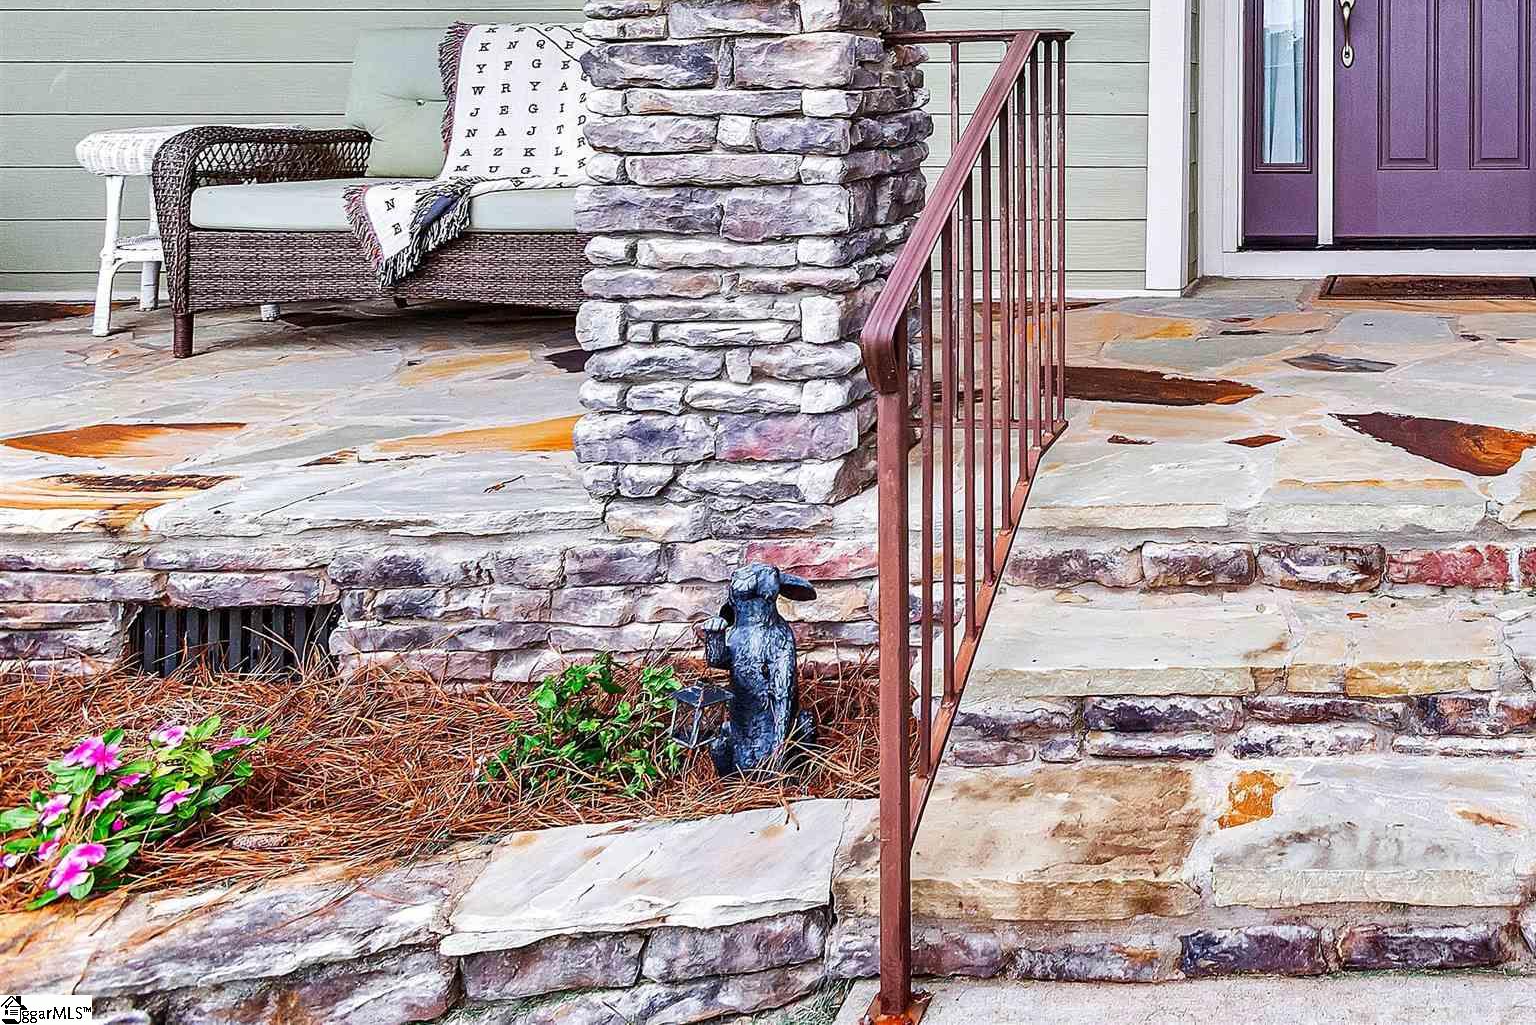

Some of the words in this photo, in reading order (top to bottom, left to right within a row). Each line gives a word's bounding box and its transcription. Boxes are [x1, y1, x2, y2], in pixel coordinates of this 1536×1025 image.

[479, 43, 491, 51] K
[507, 41, 519, 49] N
[536, 40, 545, 49] Q
[476, 64, 487, 73] Y
[504, 61, 512, 70] F
[532, 59, 542, 68] G
[472, 86, 485, 95] W
[501, 84, 511, 93] R
[529, 82, 541, 91] Y
[558, 82, 568, 91] A
[470, 108, 480, 117] J
[499, 106, 509, 115] E
[528, 104, 539, 113] G
[560, 104, 564, 113] I
[577, 115, 586, 125] D
[465, 129, 478, 137] N
[495, 128, 507, 136] A
[527, 126, 536, 135] J
[557, 125, 564, 134] T
[493, 148, 503, 156] Z
[523, 148, 536, 156] K
[554, 147, 562, 156] L
[384, 198, 396, 211] N
[392, 223, 402, 236] E
